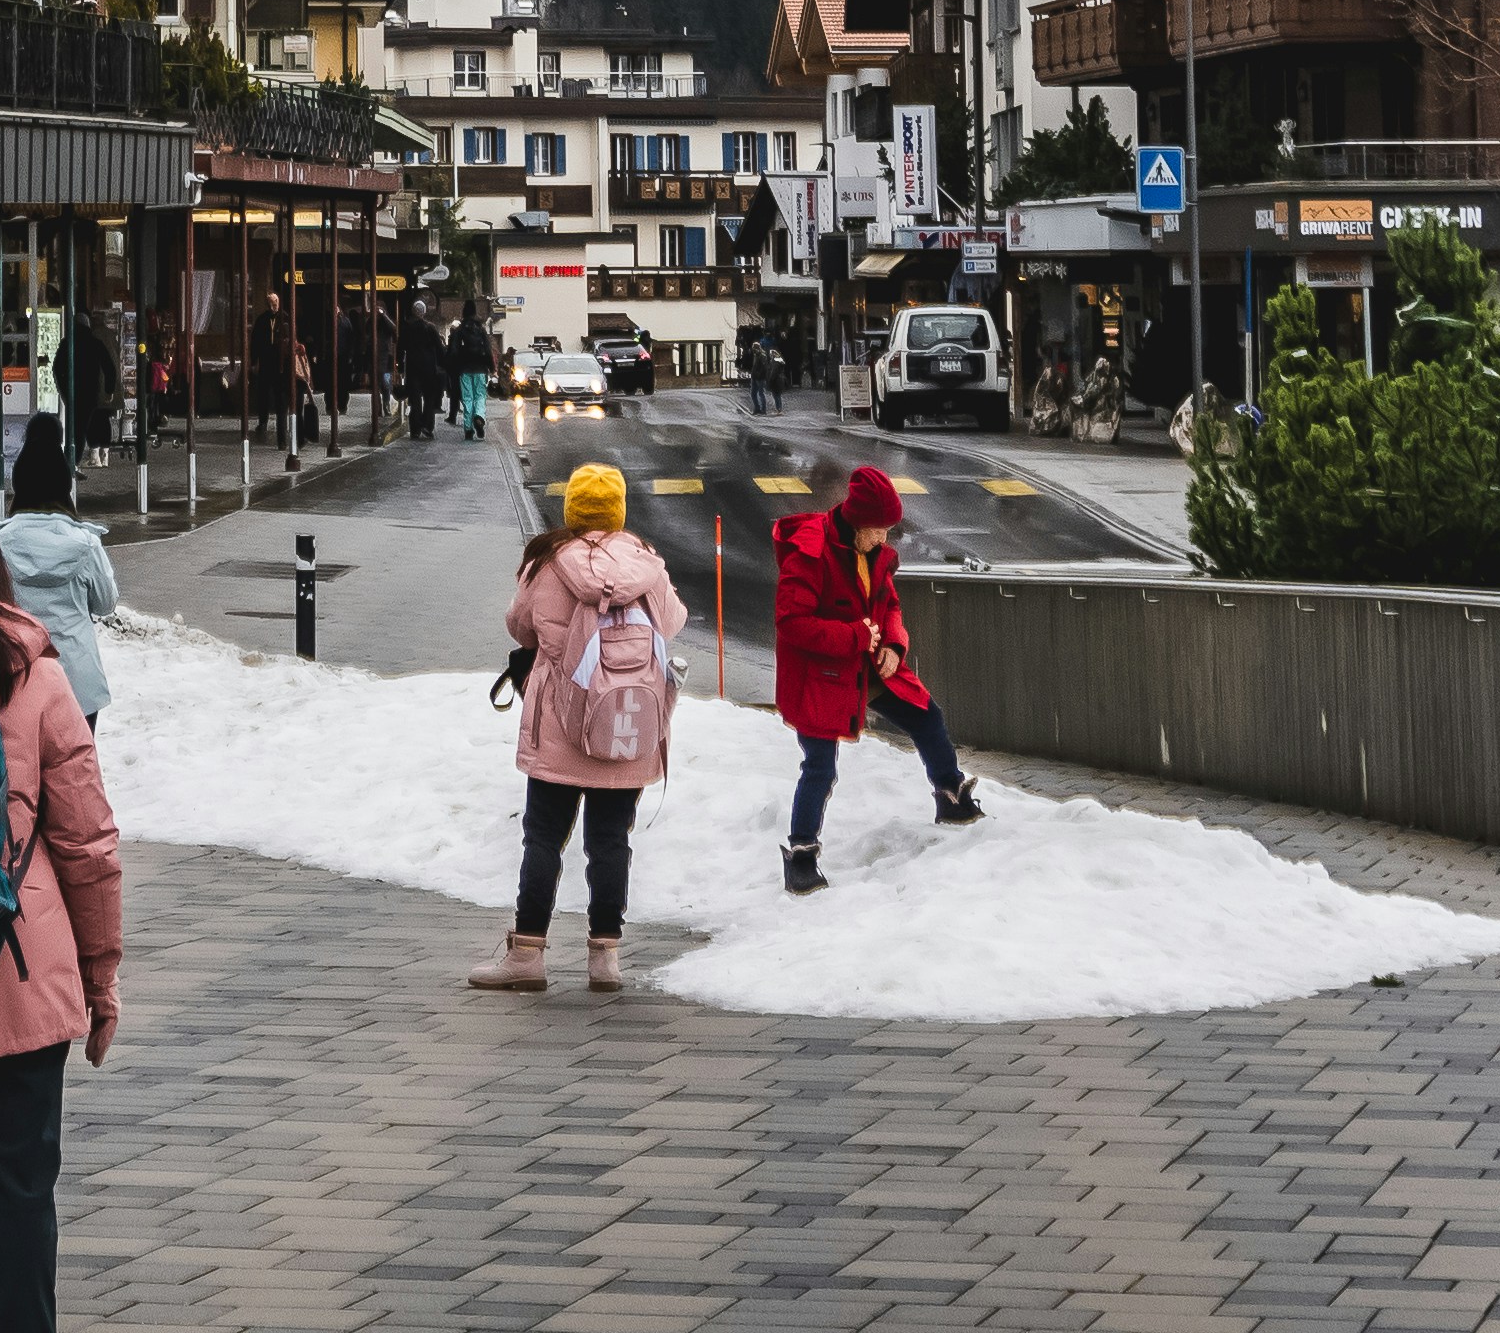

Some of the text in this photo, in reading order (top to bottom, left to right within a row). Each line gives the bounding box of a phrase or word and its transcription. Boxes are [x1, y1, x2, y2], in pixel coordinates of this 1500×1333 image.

[902, 112, 915, 193] INTERSPORT
[853, 192, 874, 201] UBS
[1300, 221, 1373, 235] GRIWARENT
[500, 265, 542, 278] HOTEL
